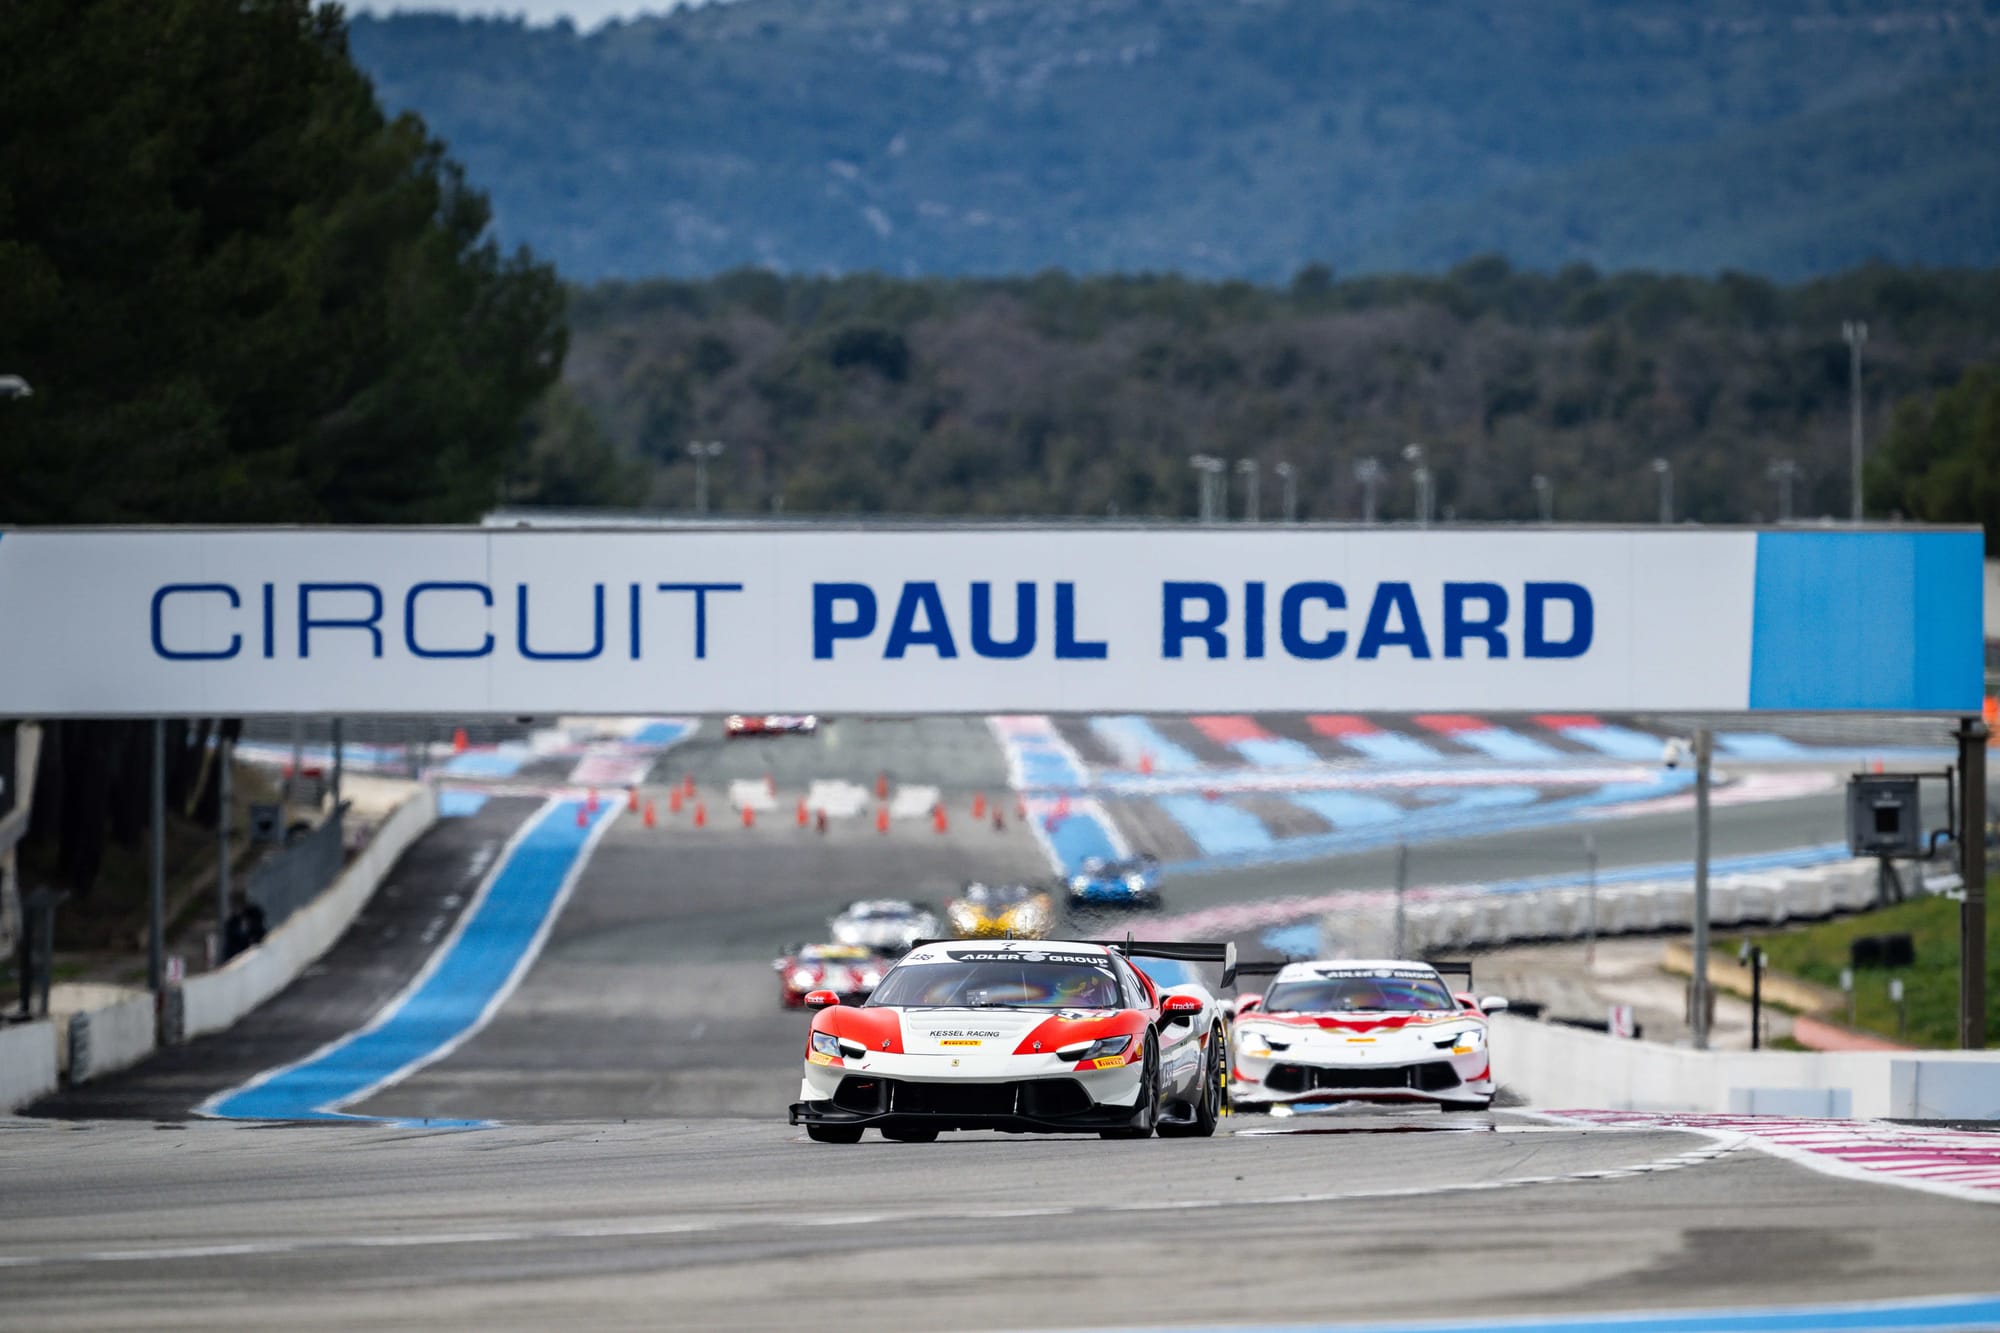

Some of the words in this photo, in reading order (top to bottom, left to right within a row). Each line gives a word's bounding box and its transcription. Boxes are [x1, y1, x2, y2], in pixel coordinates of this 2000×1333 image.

[150, 582, 743, 660] CIRCUIT
[812, 581, 1107, 660] PAUL
[1162, 581, 1594, 660] RICARD
[959, 953, 1020, 962] ADLER
[1049, 955, 1108, 966] GROUP
[966, 1030, 1000, 1038] RACING
